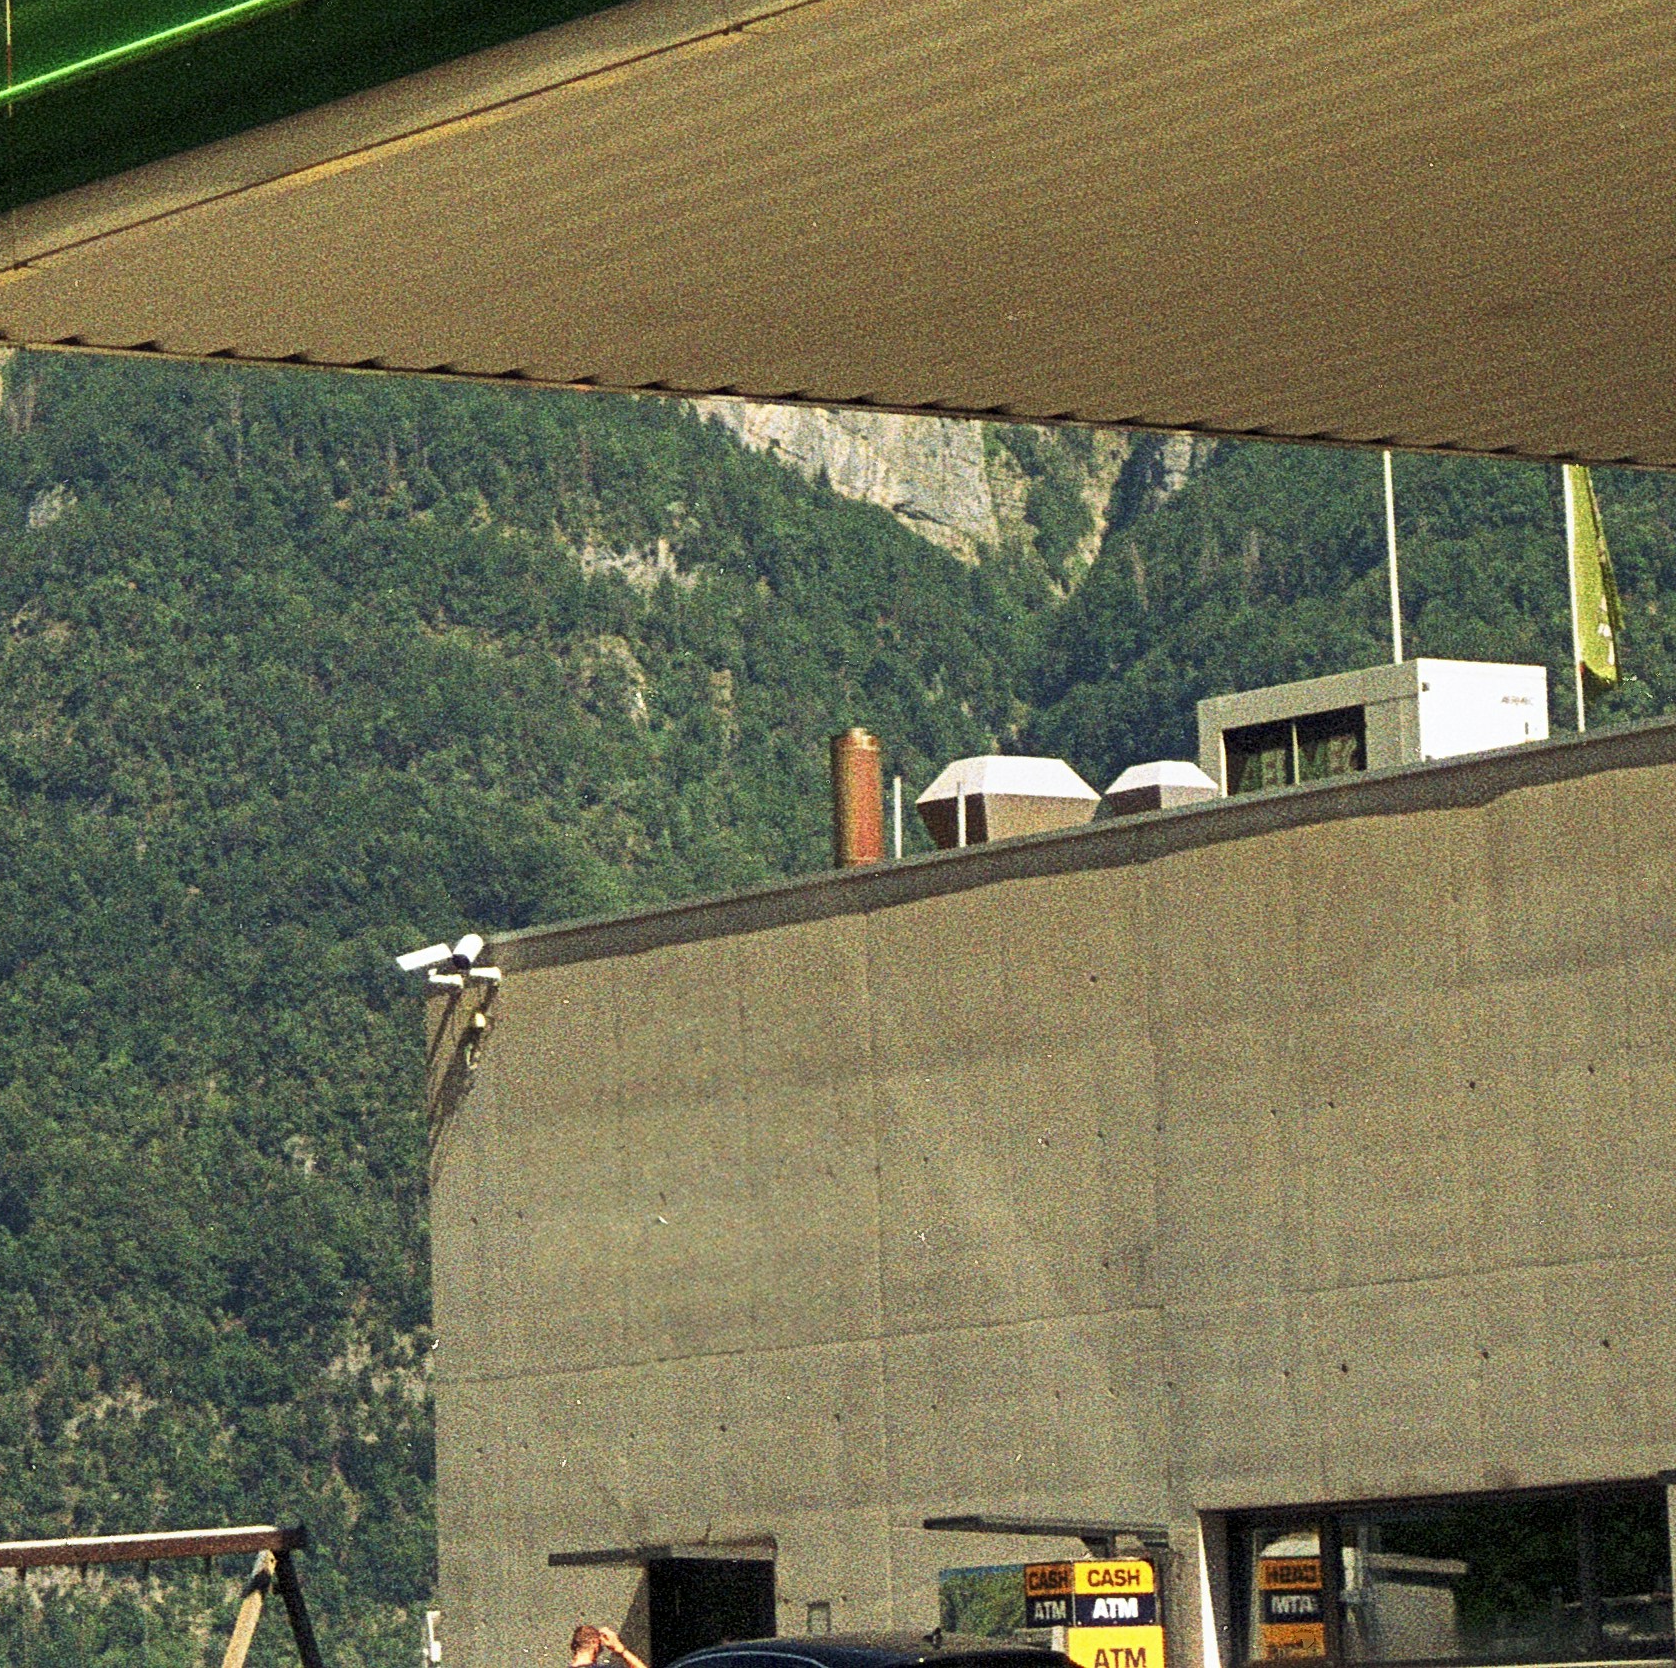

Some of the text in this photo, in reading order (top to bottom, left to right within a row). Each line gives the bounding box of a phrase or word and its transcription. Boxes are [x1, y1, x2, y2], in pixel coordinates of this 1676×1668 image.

[1028, 1569, 1068, 1590] CASH
[1087, 1568, 1140, 1587] CASH
[1034, 1600, 1066, 1620] ATM
[1092, 1597, 1139, 1619] ATM
[1094, 1647, 1147, 1668] ATM
